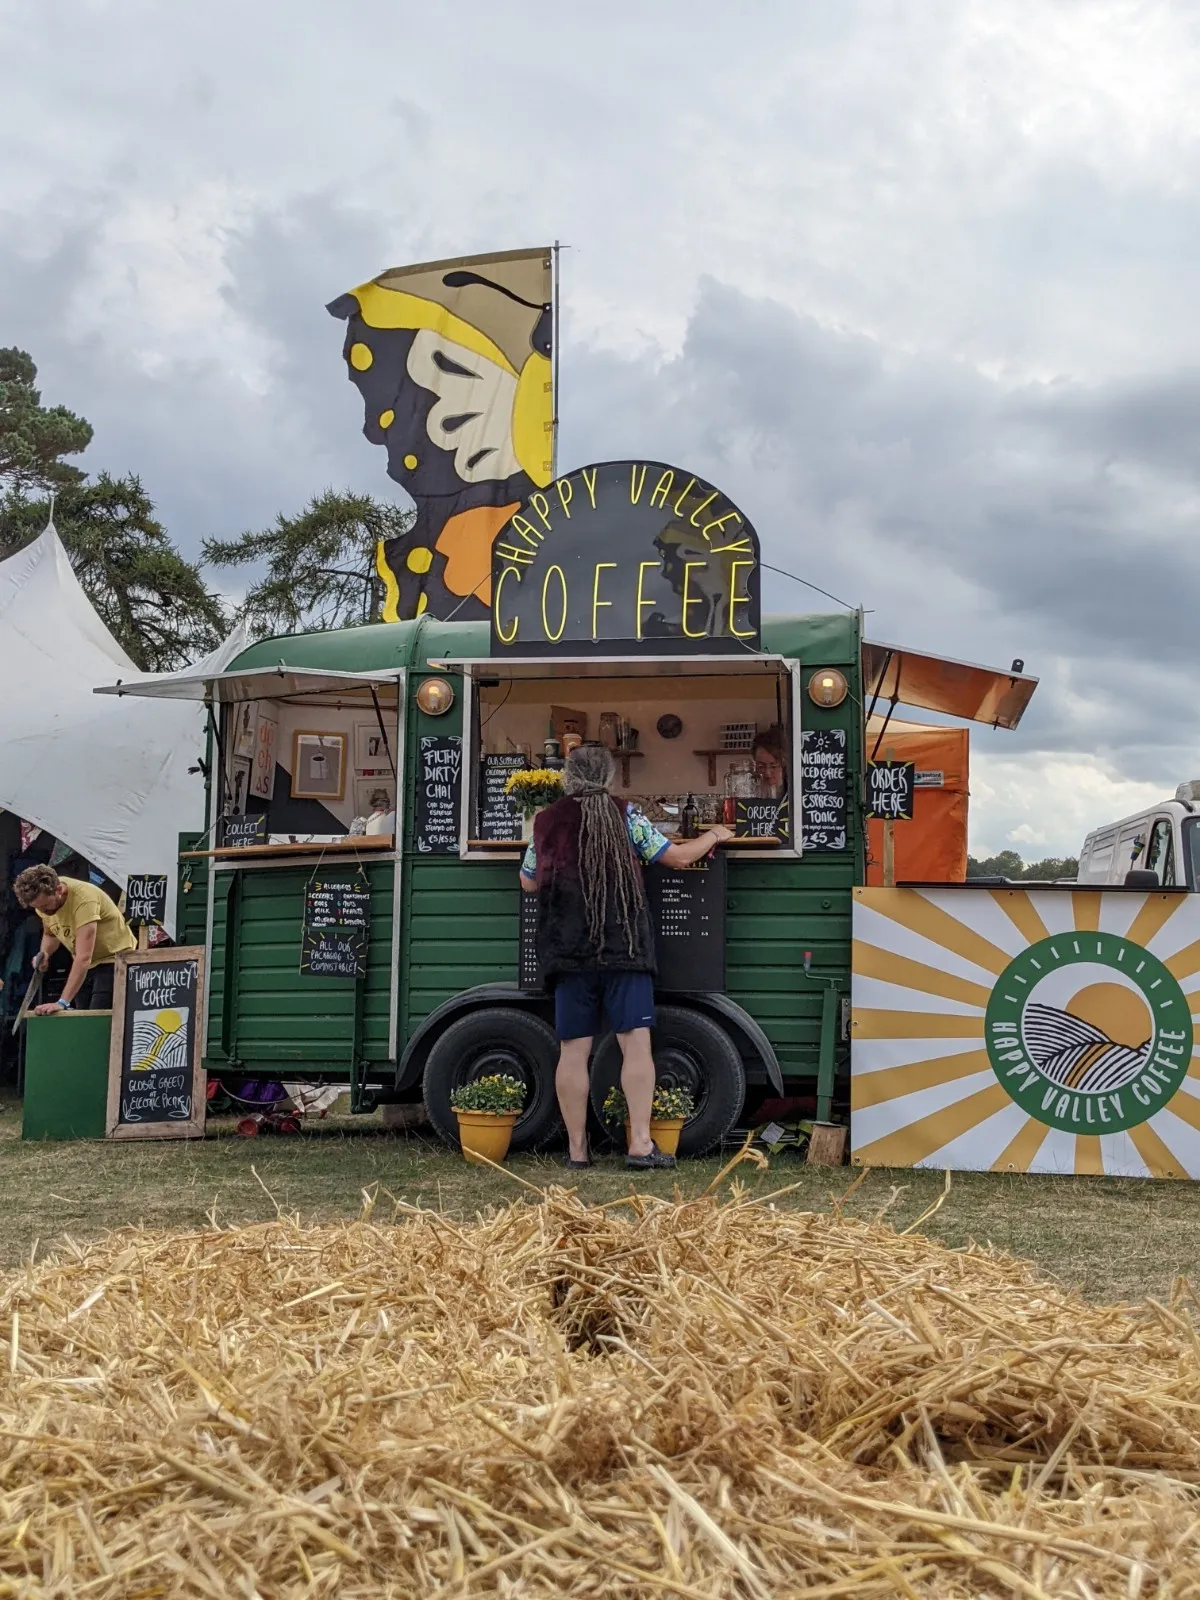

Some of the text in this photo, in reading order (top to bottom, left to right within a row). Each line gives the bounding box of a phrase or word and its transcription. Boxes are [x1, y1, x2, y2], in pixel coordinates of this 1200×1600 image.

[496, 465, 752, 564] HAPPY VALLEY
[495, 561, 757, 642] COFFEE
[423, 749, 461, 767] FILTHY
[424, 766, 460, 784] DIRTY
[820, 767, 845, 780] COFFEE
[871, 766, 908, 794] ORDER
[426, 784, 451, 800] CHAI
[811, 780, 827, 790] €5
[802, 794, 844, 809] ESPRESSO
[871, 791, 907, 817] HERE
[747, 806, 778, 820] ORDER
[806, 810, 837, 823] TONIC
[226, 822, 259, 836] COLLECT
[751, 822, 776, 837] HERE
[232, 836, 254, 847] HERE
[810, 832, 828, 844] €5
[129, 880, 166, 900] COLLECT
[130, 900, 158, 920] HERE
[320, 941, 350, 952] ALL OUR
[347, 952, 355, 960] IS
[135, 967, 192, 992] HAPPY VALLEY
[142, 987, 177, 1006] COFFEE
[992, 1022, 1186, 1124] HAPPY VALLEY COFFEE
[158, 1075, 185, 1093] GREEN
